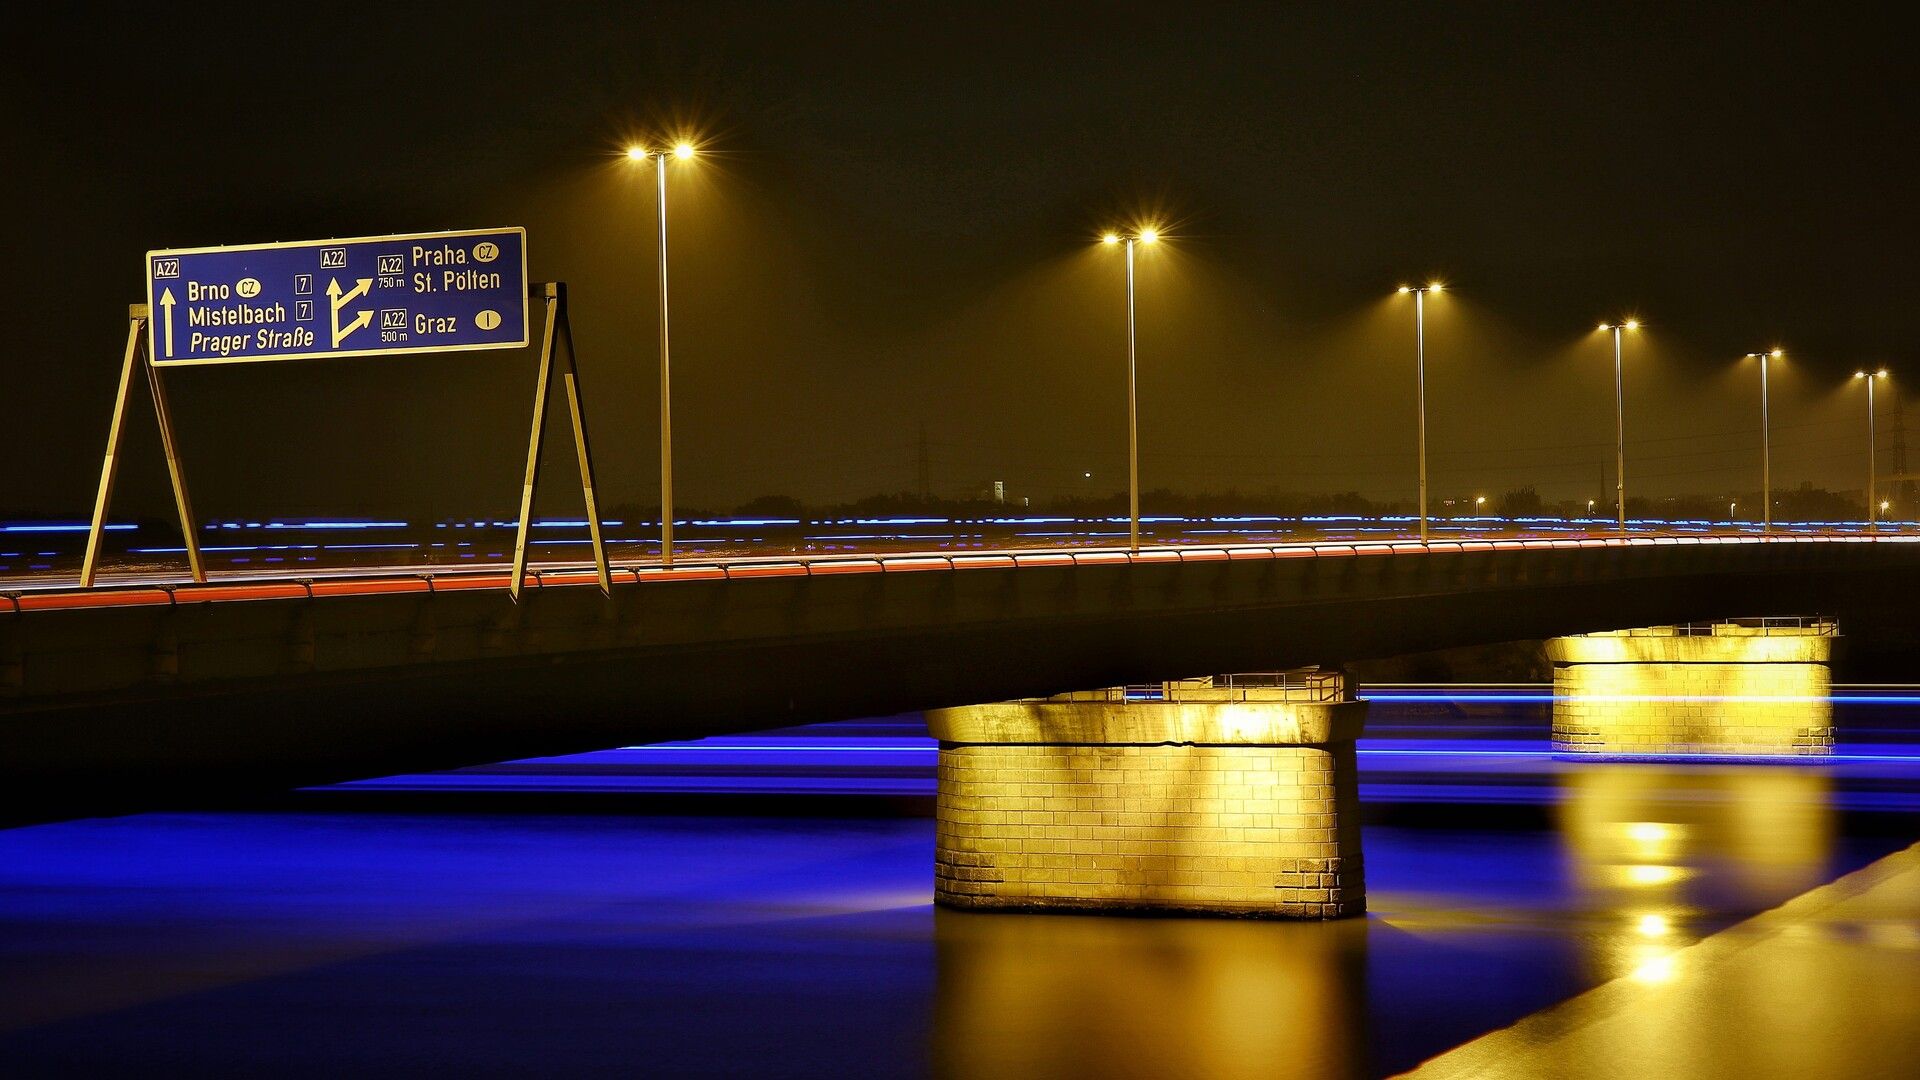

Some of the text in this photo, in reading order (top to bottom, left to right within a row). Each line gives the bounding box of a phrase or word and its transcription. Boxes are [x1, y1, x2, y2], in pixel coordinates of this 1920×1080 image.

[323, 251, 345, 267] A22
[478, 245, 493, 259] CZ
[156, 262, 178, 277] A22
[380, 258, 402, 273] A22
[378, 277, 405, 289] 750 m
[414, 269, 500, 293] St. Pölten
[187, 277, 307, 302] Brno CZ 7
[188, 301, 308, 327] Mistelbach 7
[383, 312, 406, 328] A22
[415, 313, 457, 335] Graz
[190, 326, 314, 357] Prager Straße
[381, 331, 408, 343] 500 m
